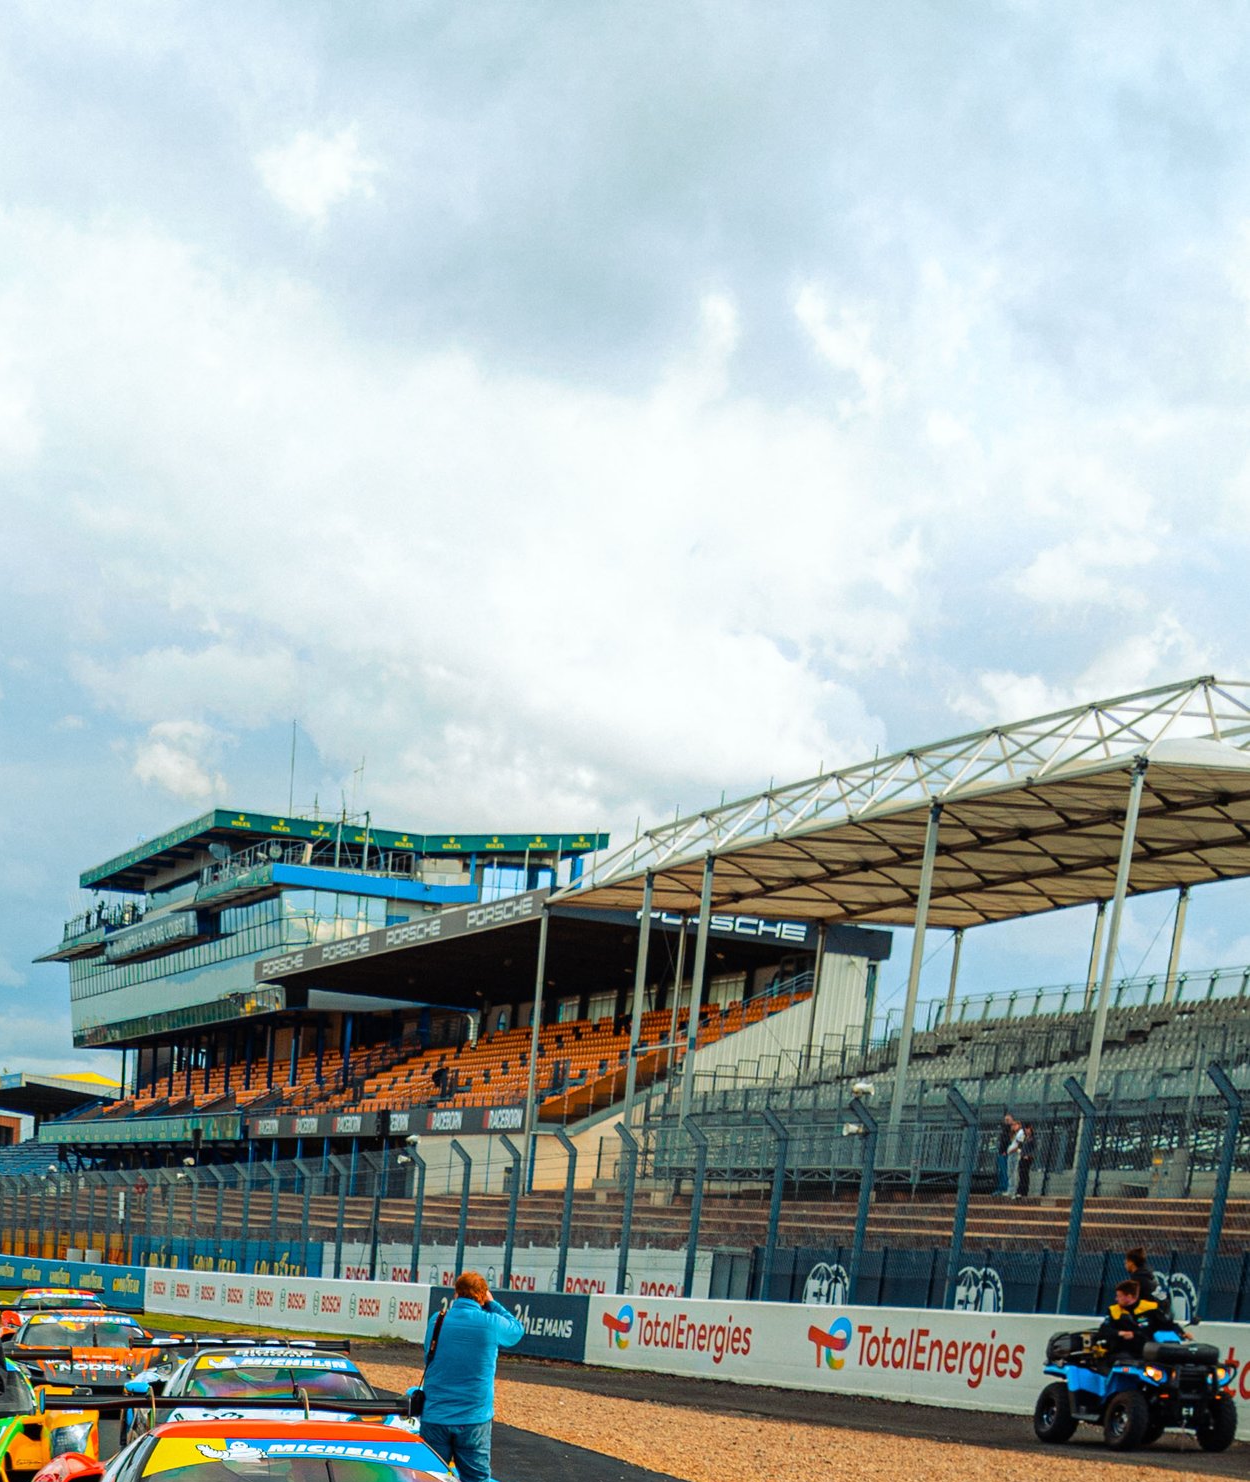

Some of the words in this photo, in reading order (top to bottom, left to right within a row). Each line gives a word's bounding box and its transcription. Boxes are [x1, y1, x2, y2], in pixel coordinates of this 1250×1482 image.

[466, 896, 533, 928] PORSCHE
[386, 919, 441, 947] PORSCHE
[636, 911, 807, 942] OSCHE
[322, 937, 370, 961] PORSCHE
[262, 953, 304, 976] PORSCHE
[487, 1109, 524, 1129] RACEBORN
[227, 1288, 243, 1304] BOSCH
[256, 1289, 274, 1307] BOSCH
[287, 1292, 306, 1310] BOSCH
[321, 1295, 342, 1314] BOSCH
[358, 1298, 380, 1317] BOSCH
[399, 1301, 423, 1321] BOSCH
[530, 1317, 543, 1336] LE
[544, 1318, 574, 1339] MANS
[637, 1310, 752, 1365] TotalEnergies
[242, 1357, 347, 1370] MICHELIN
[857, 1324, 1027, 1388] TotalEnergies
[267, 1443, 411, 1463] MICHELIN
